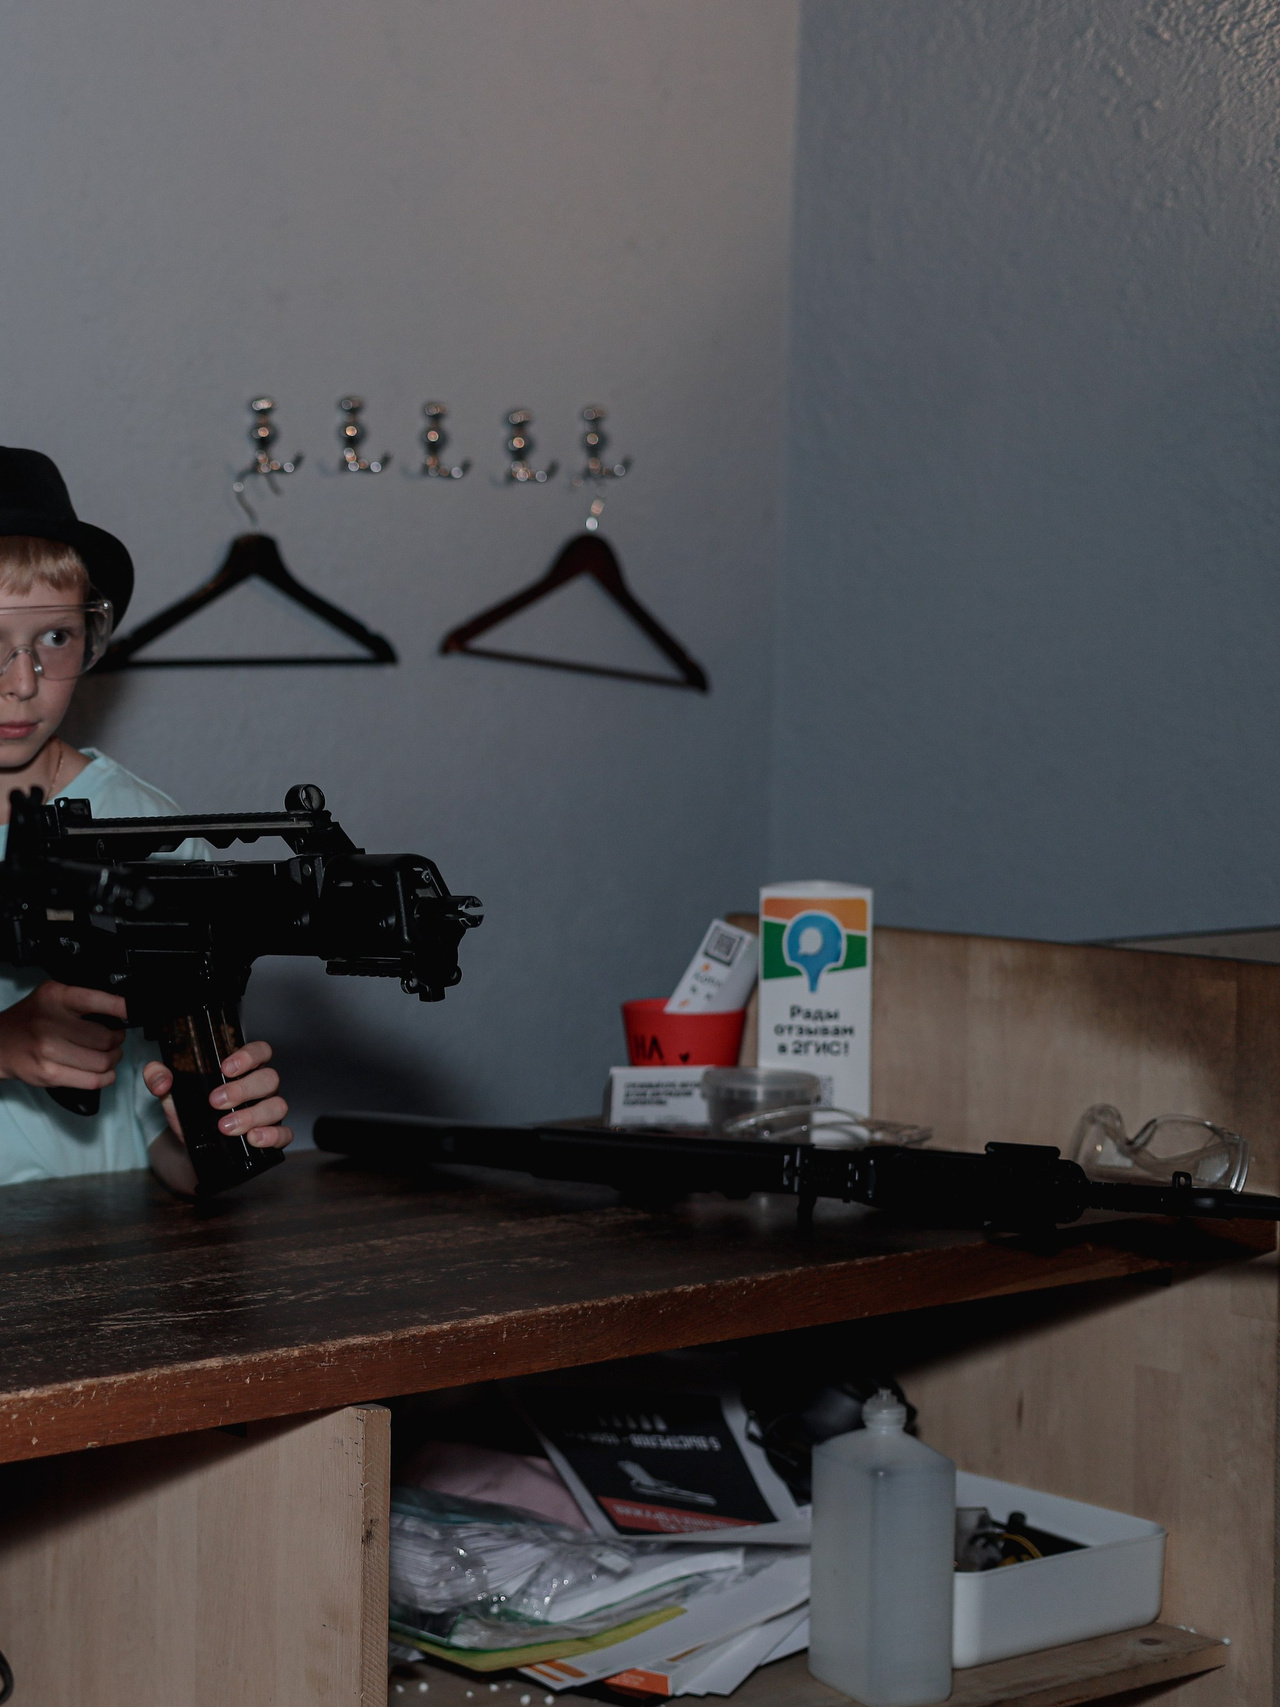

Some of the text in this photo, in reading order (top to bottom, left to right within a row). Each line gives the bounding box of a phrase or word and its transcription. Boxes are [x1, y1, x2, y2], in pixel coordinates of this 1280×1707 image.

[789, 1005, 840, 1021] Рады
[774, 1024, 855, 1037] отзывам
[778, 1040, 850, 1056] в 2ГИС!
